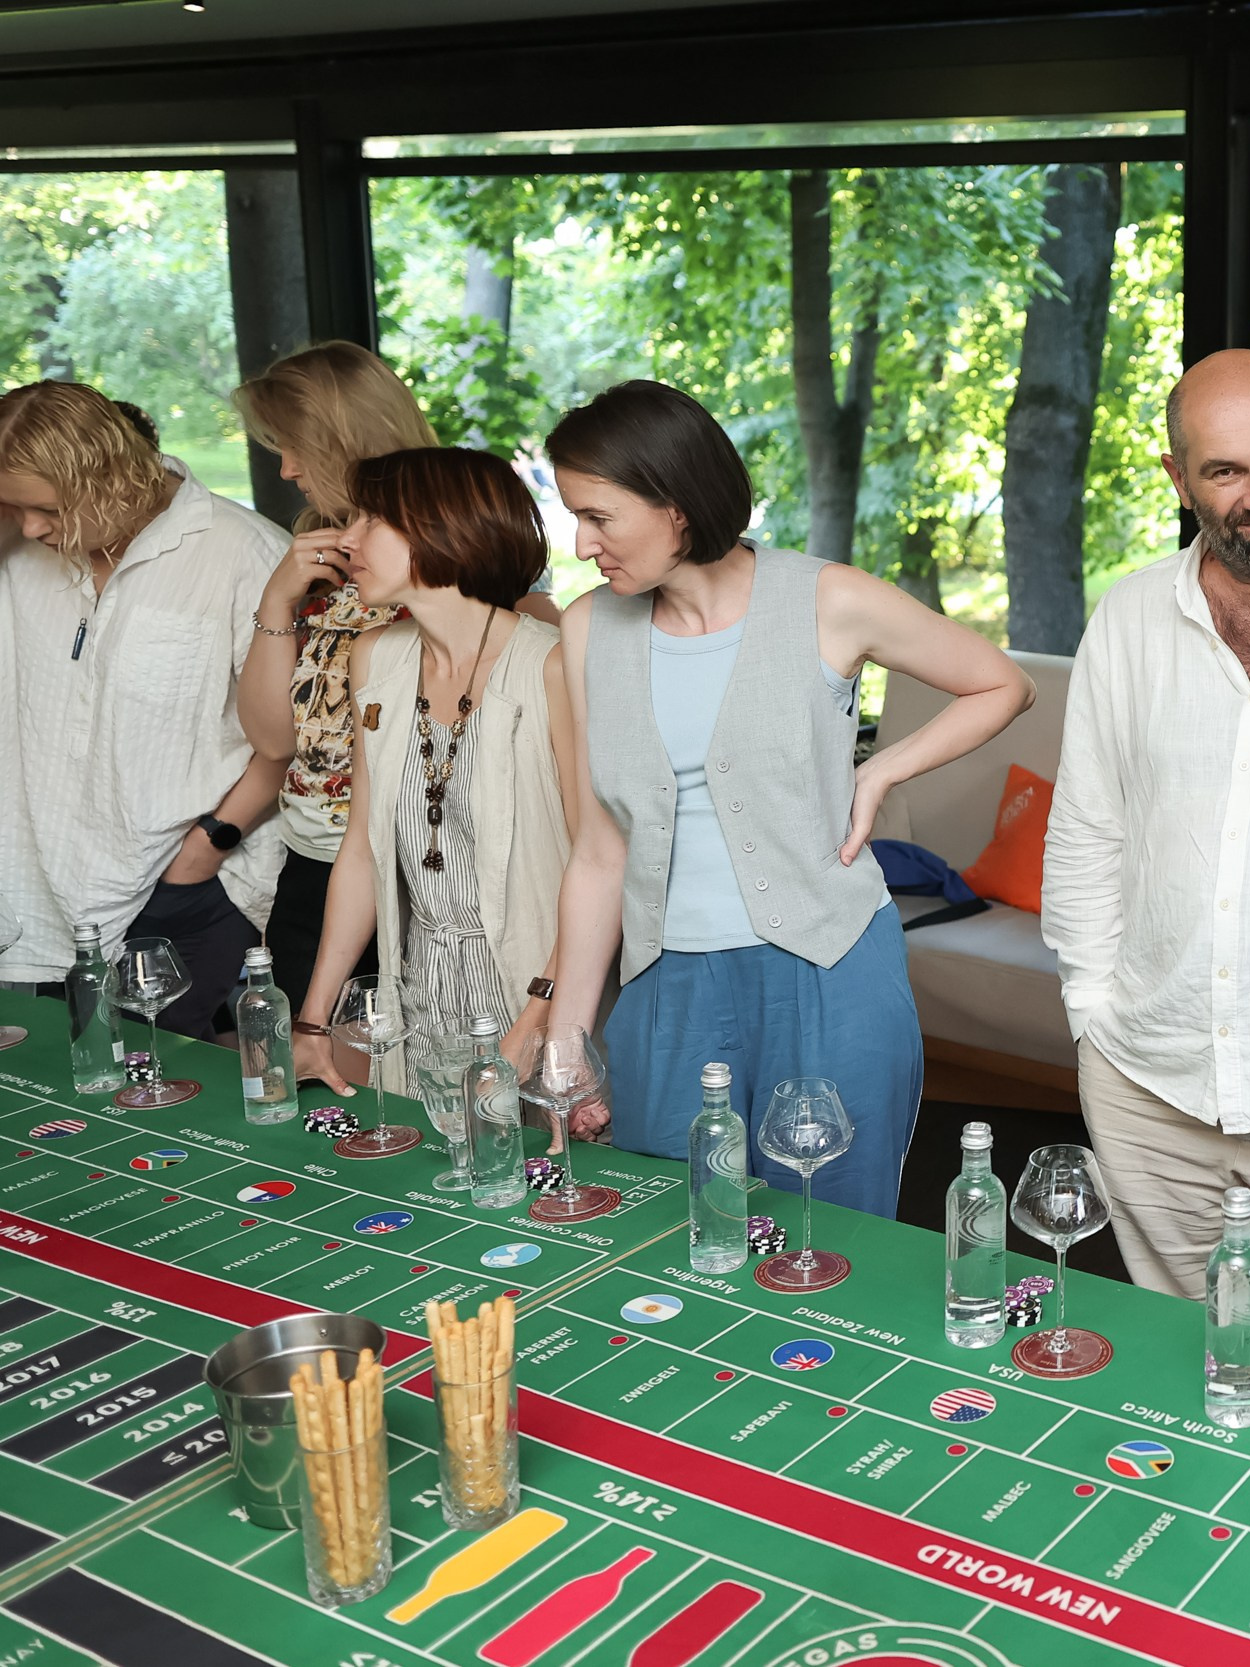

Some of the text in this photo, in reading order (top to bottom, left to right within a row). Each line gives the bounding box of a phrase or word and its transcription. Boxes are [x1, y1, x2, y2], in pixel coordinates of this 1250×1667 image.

[100, 1105, 127, 1117] USA
[178, 1128, 250, 1152] South Africa
[2, 1170, 60, 1192] MALBEC
[303, 1163, 338, 1177] Chile
[597, 1168, 644, 1182] COUNTRY
[58, 1187, 149, 1222] SANGIOVESE
[404, 1190, 467, 1209] Australia
[0, 1225, 48, 1245] NEW
[132, 1210, 225, 1249] TEMPRANILLO
[507, 1216, 614, 1246] Other countries
[222, 1236, 302, 1271] PINOT NOIR
[322, 1263, 376, 1291] MERLOT
[662, 1266, 741, 1296] Argentina
[103, 1301, 157, 1323] 13%
[792, 1306, 906, 1346] New Zealand
[516, 1326, 573, 1362] ABERNET
[530, 1338, 579, 1365] FRANC
[618, 1365, 681, 1404] ZWEIGELT
[988, 1363, 1024, 1381] USA
[29, 1371, 112, 1410] 2016
[76, 1386, 157, 1426] 2015
[123, 1402, 205, 1443] 2014
[730, 1400, 793, 1443] SAPERAVI
[1120, 1402, 1238, 1445] South Africa
[846, 1439, 895, 1476] SYRAH/
[866, 1446, 914, 1480] SHIRAZ
[982, 1480, 1032, 1523] MALBEC
[1105, 1511, 1177, 1580] SANGIOVESE
[916, 1543, 1122, 1626] NEW WORLD
